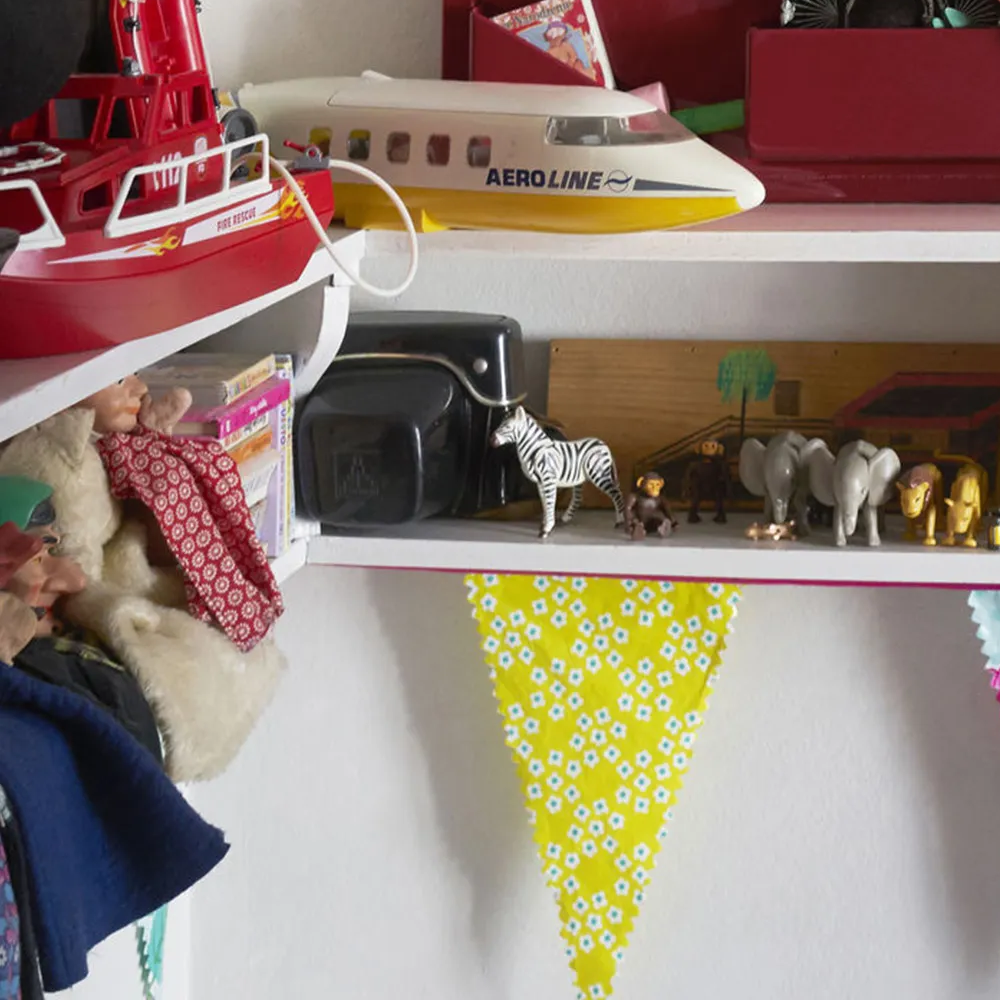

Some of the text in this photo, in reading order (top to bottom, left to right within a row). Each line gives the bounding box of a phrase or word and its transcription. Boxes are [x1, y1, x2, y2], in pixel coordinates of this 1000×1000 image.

[485, 168, 603, 190] AEROLINE
[216, 207, 256, 232] FIRE RESCUE
